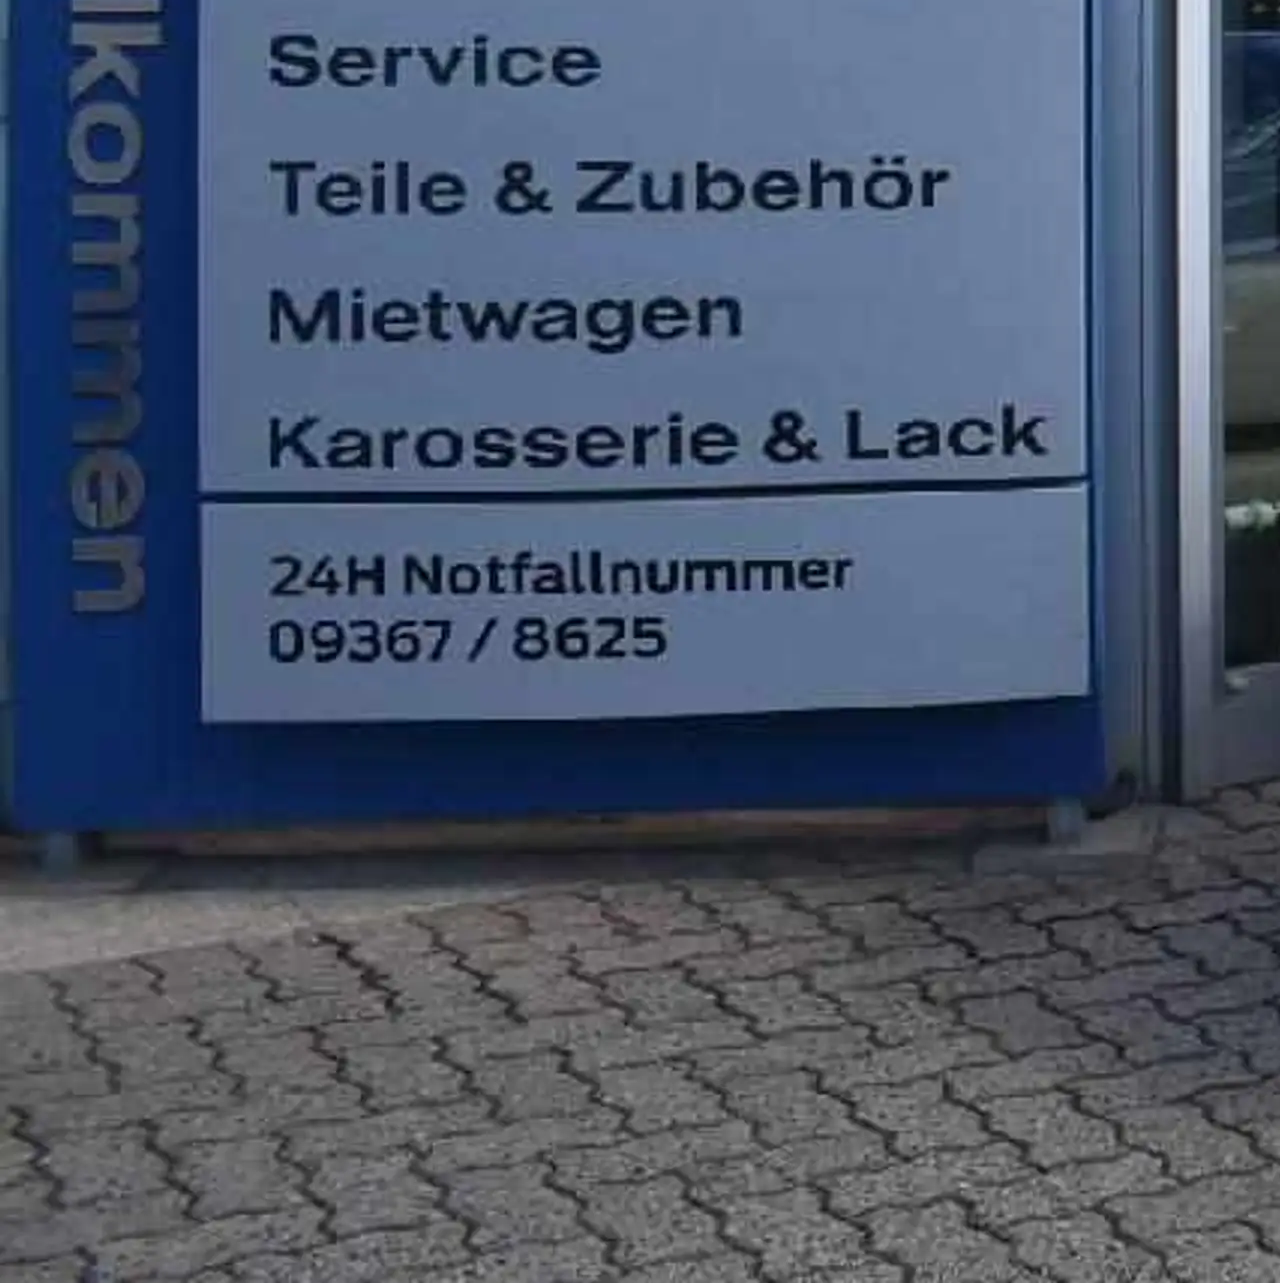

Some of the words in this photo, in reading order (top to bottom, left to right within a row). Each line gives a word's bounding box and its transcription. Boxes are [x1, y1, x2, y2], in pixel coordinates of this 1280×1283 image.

[269, 34, 602, 88] Service
[269, 160, 467, 217] Teile
[494, 161, 553, 216] &
[575, 156, 951, 214] Zubehör
[269, 288, 743, 355] Mietwagen
[269, 412, 740, 470] Karosserie
[762, 410, 820, 464] &
[847, 403, 1047, 460] Lack
[270, 555, 386, 597] 24H
[403, 551, 854, 595] Notfallnummer
[269, 619, 452, 664] 09367
[512, 616, 668, 661] 8625
